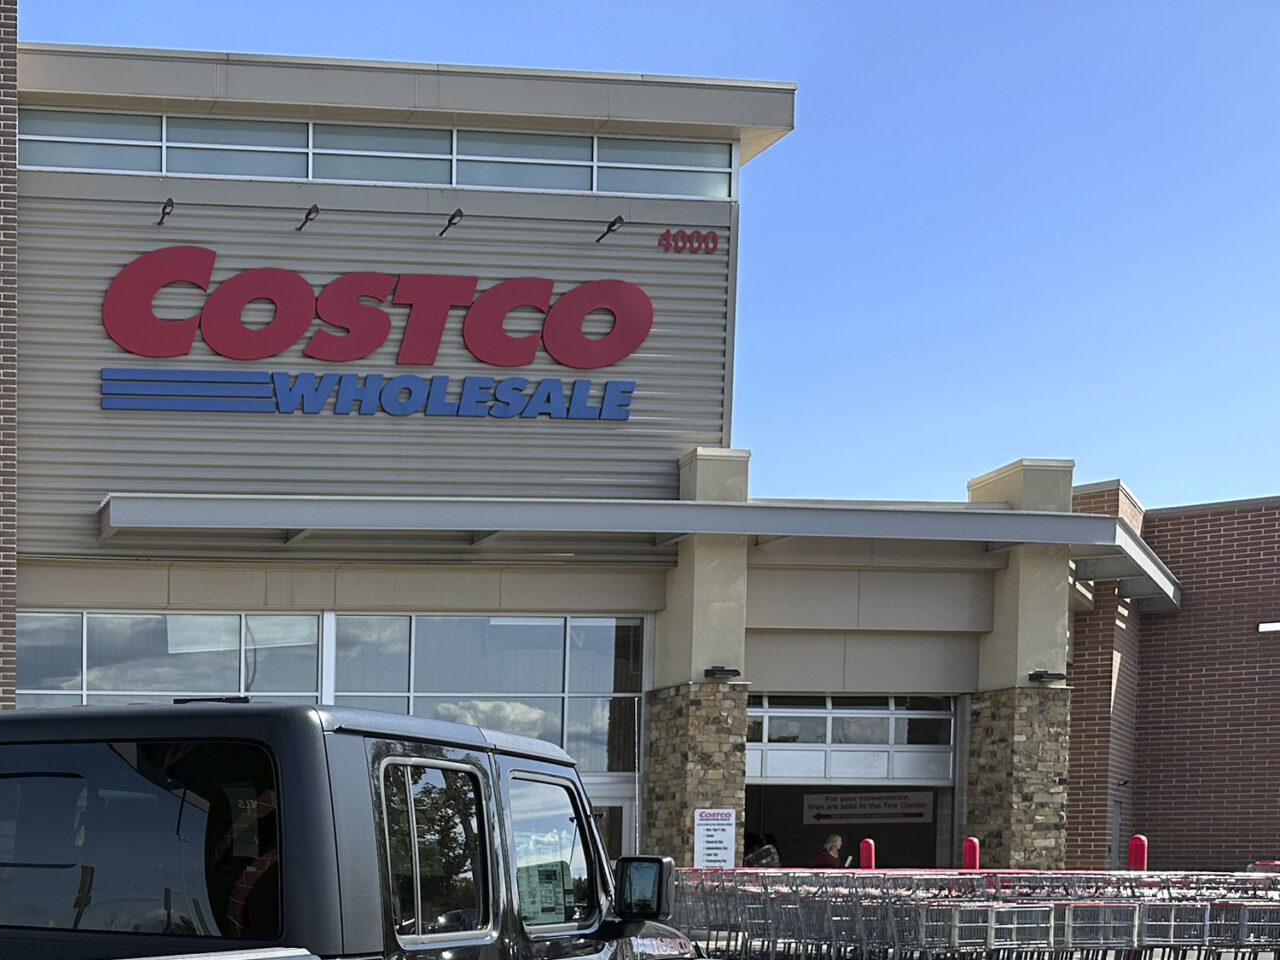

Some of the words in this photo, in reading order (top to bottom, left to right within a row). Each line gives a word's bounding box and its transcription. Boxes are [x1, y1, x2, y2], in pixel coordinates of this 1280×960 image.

[657, 228, 719, 254] 4000
[101, 245, 654, 369] COSTCO
[271, 371, 637, 421] WHOLESALE
